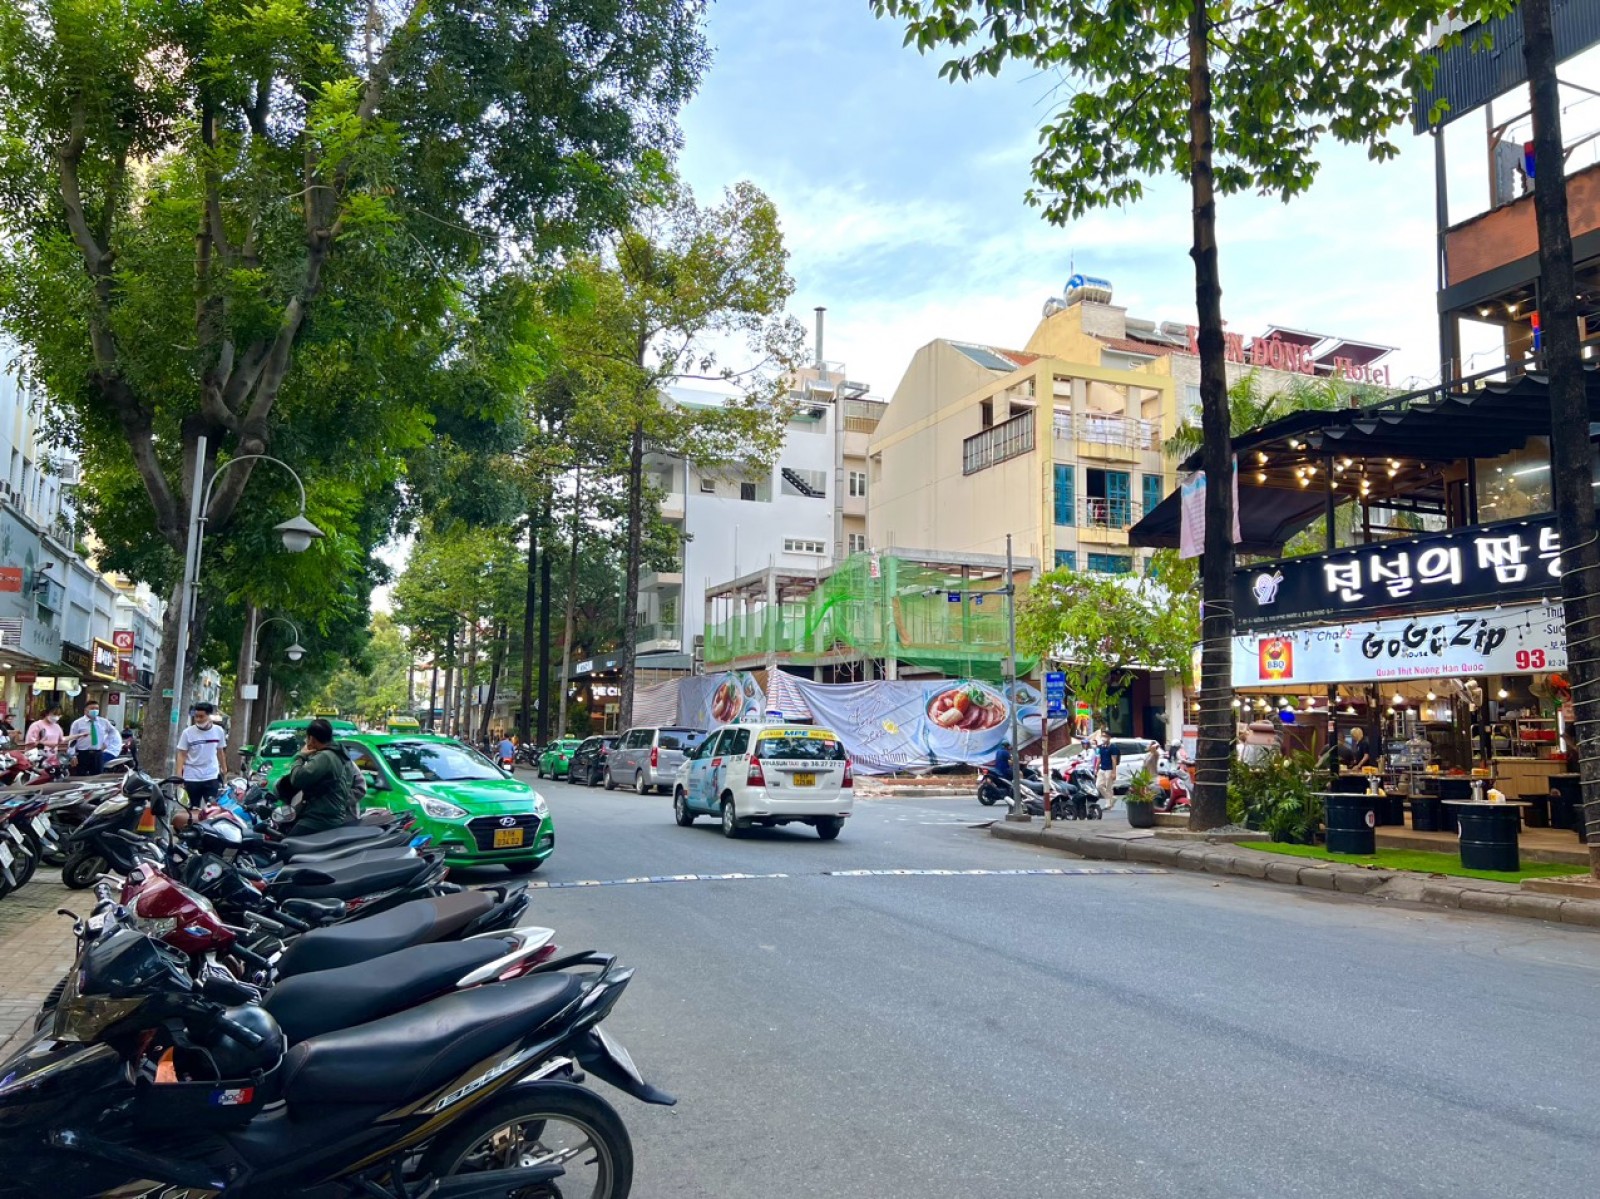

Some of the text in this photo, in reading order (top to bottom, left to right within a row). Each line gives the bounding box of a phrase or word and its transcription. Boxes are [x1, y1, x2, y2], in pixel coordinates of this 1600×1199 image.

[1251, 332, 1315, 375] ĐÔNG
[1334, 355, 1392, 386] Hotel
[1323, 546, 1462, 603] 전설의
[1450, 618, 1507, 656] Zip
[1267, 660, 1285, 670] BBQ
[1515, 648, 1547, 671] 93
